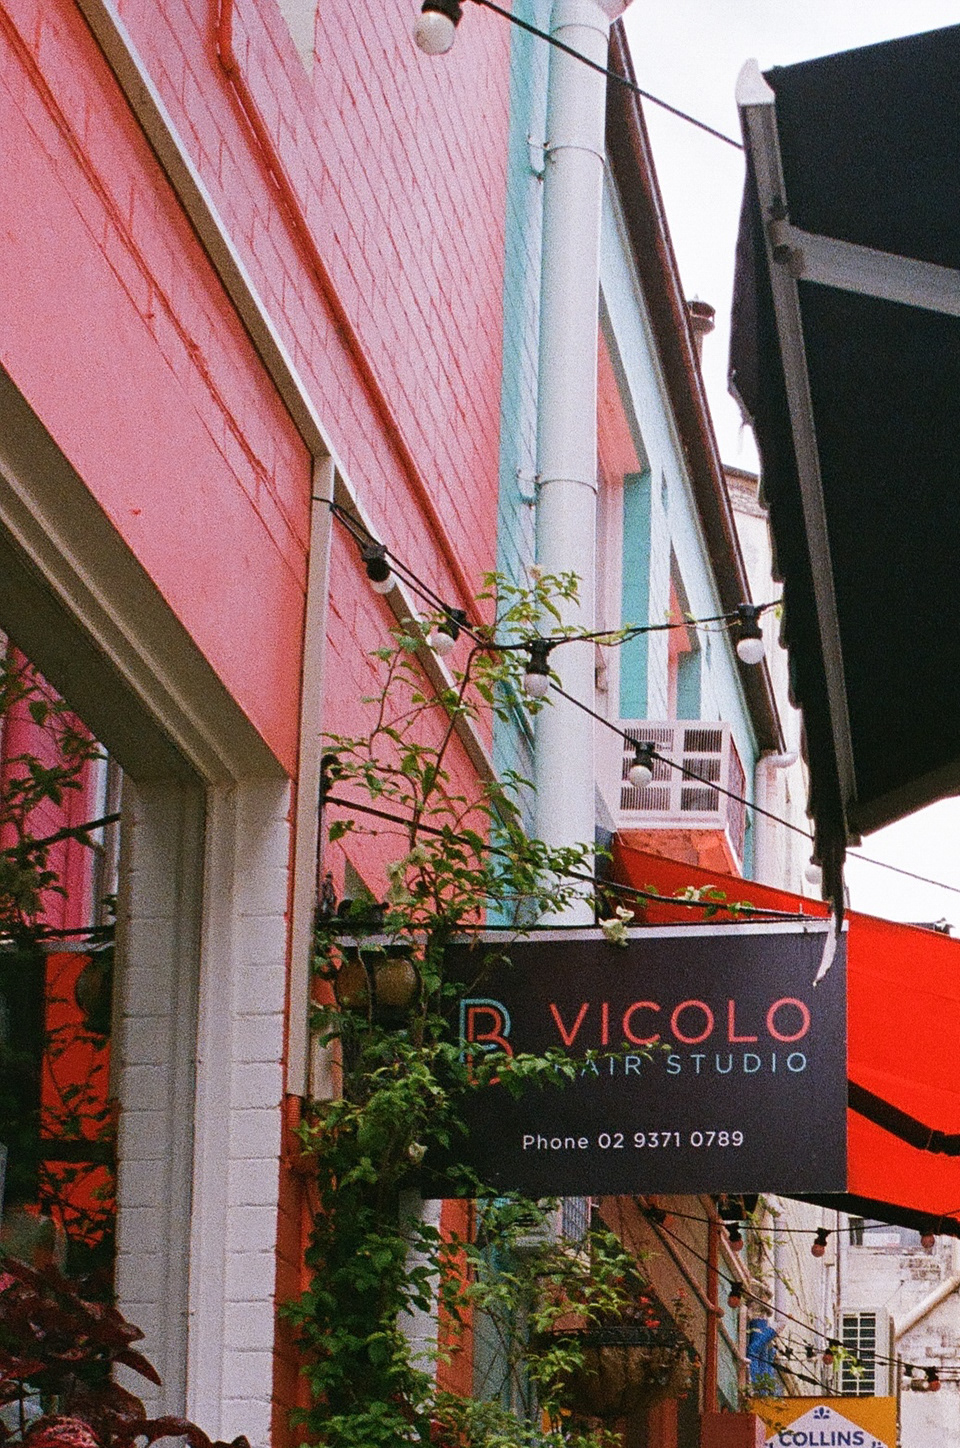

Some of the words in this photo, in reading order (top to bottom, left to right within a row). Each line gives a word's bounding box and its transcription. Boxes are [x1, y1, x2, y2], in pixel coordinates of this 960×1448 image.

[549, 997, 812, 1047] VICOLO
[666, 1051, 808, 1076] STUDIO
[522, 1133, 589, 1151] Phone
[598, 1132, 625, 1150] 02
[633, 1131, 681, 1149] 9371
[690, 1130, 745, 1148] 0789
[778, 1430, 865, 1447] COLLINS
